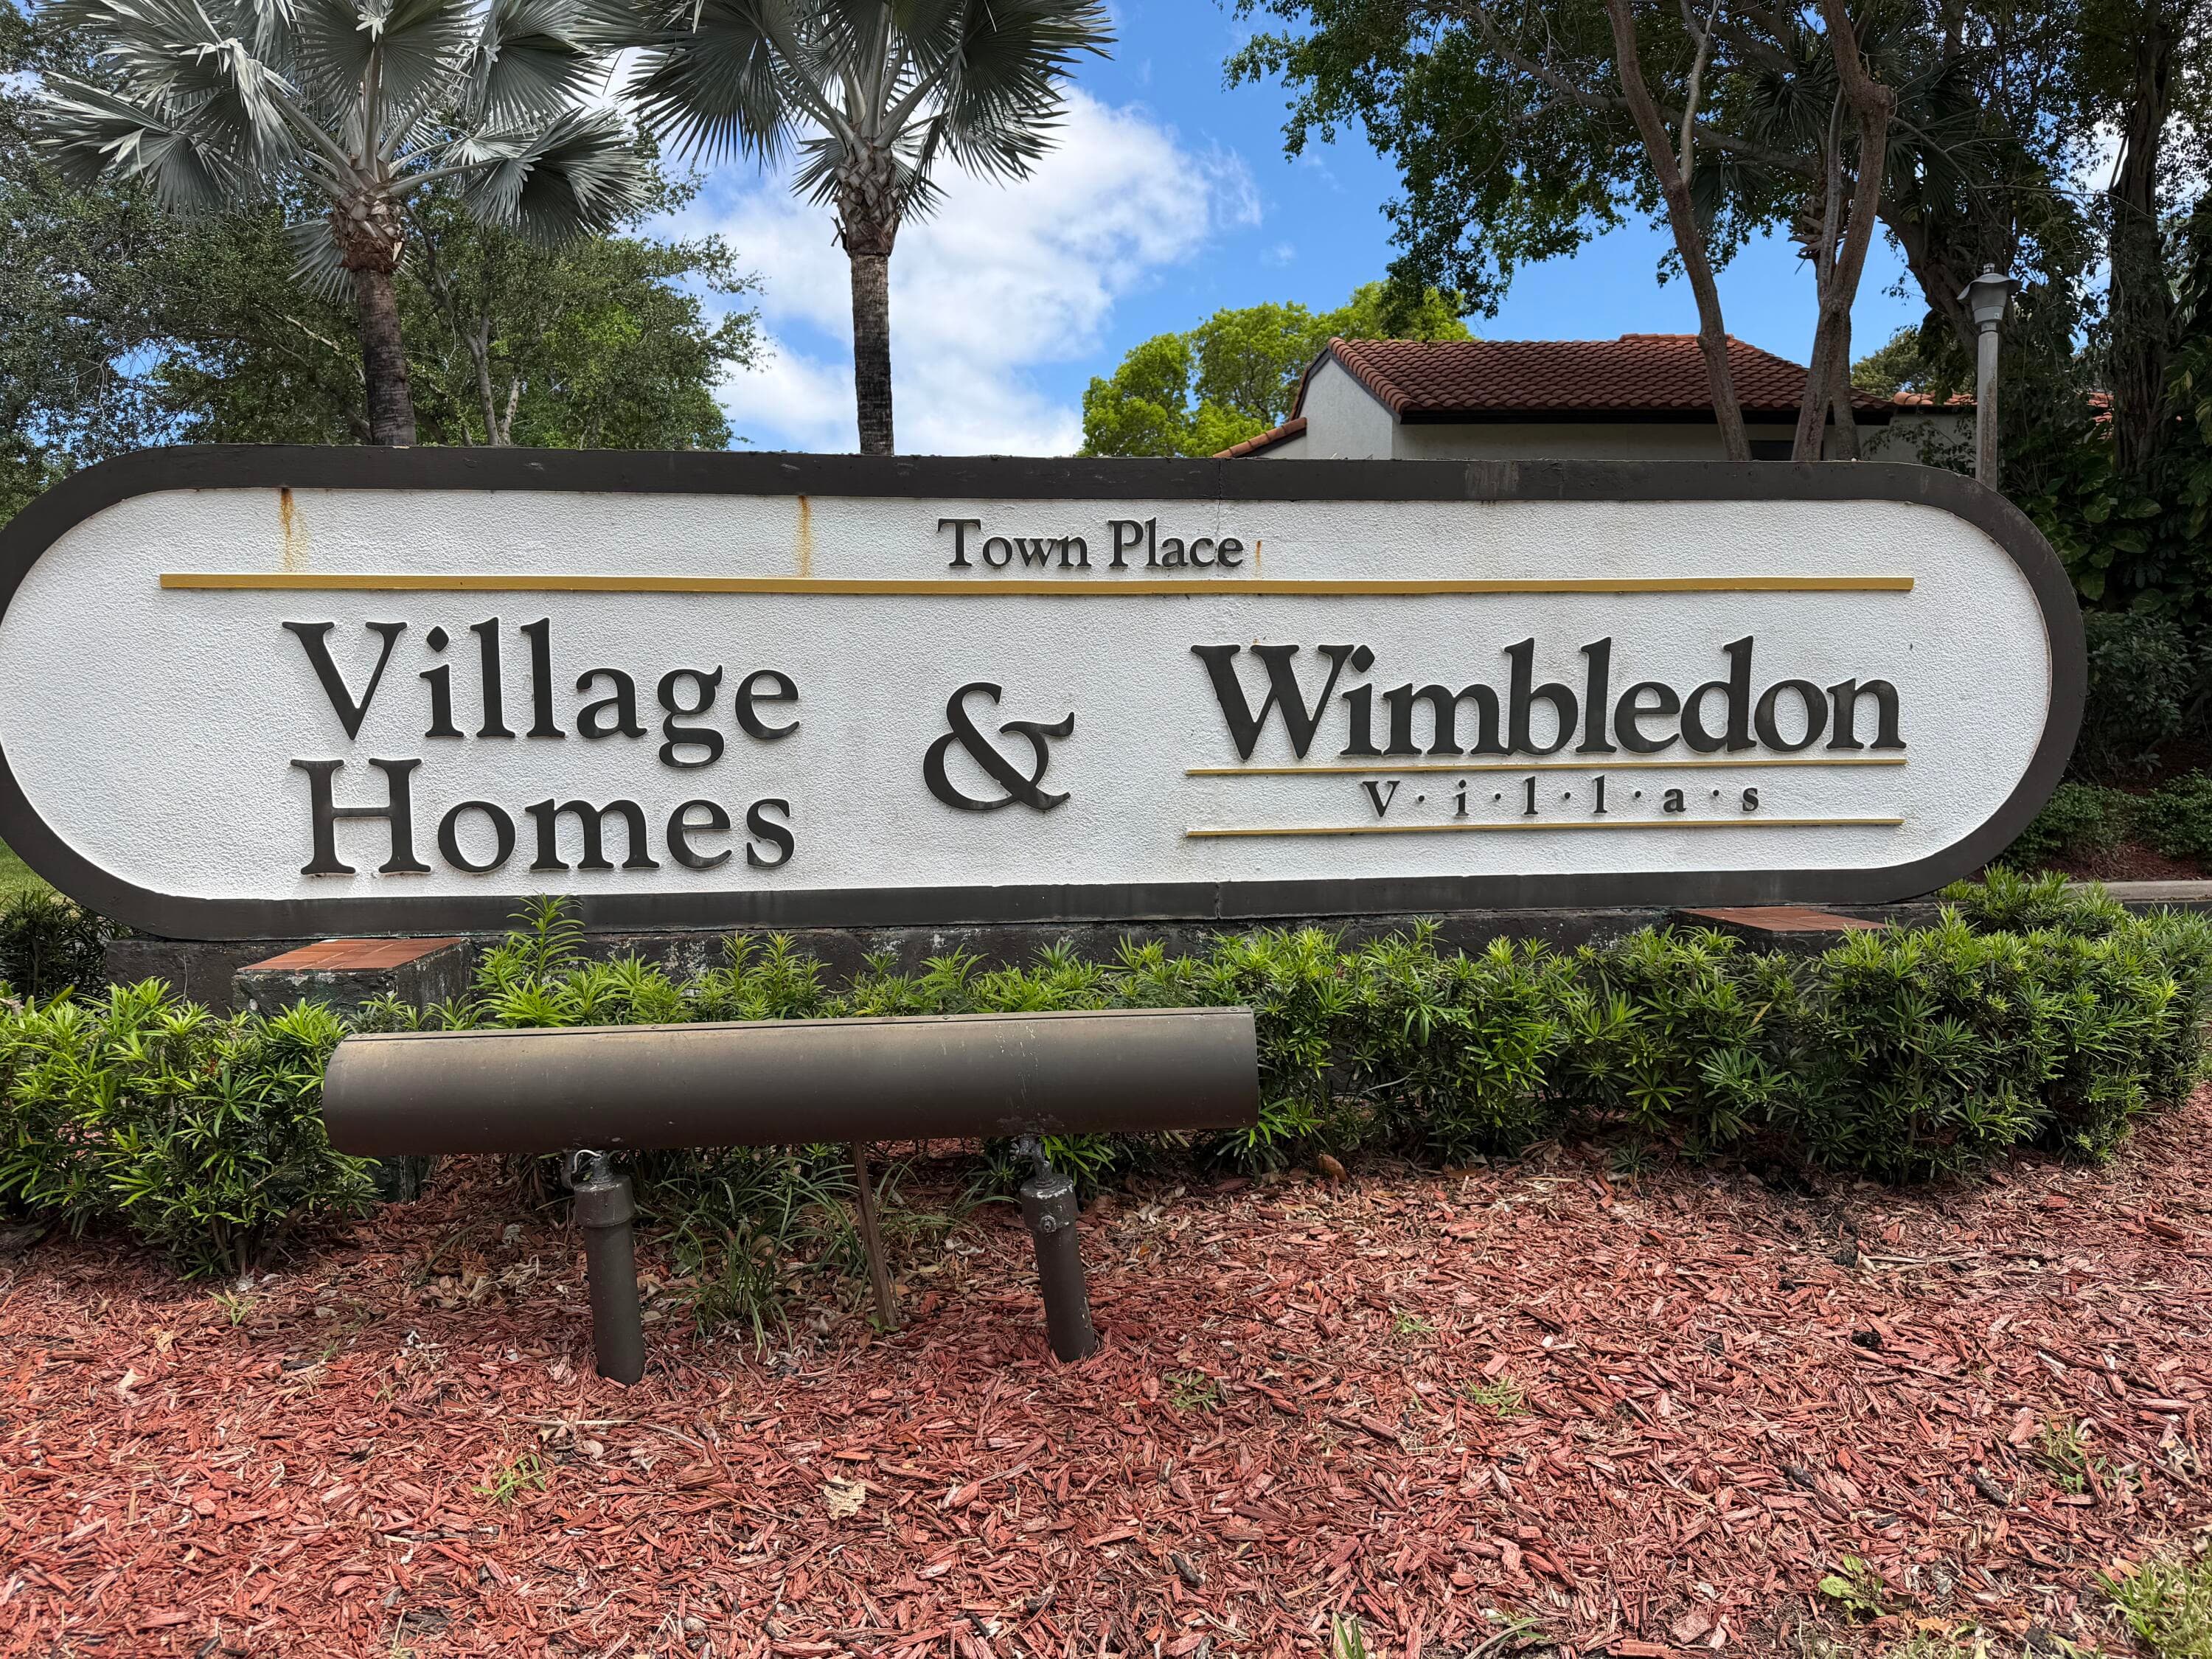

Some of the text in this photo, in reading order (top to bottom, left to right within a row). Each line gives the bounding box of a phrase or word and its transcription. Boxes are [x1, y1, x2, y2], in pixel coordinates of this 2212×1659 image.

[936, 518, 1244, 571] Town Place
[282, 616, 800, 773] Village
[922, 682, 1075, 815] &
[1190, 636, 1907, 764] Wimbledon
[289, 758, 796, 878] Homes
